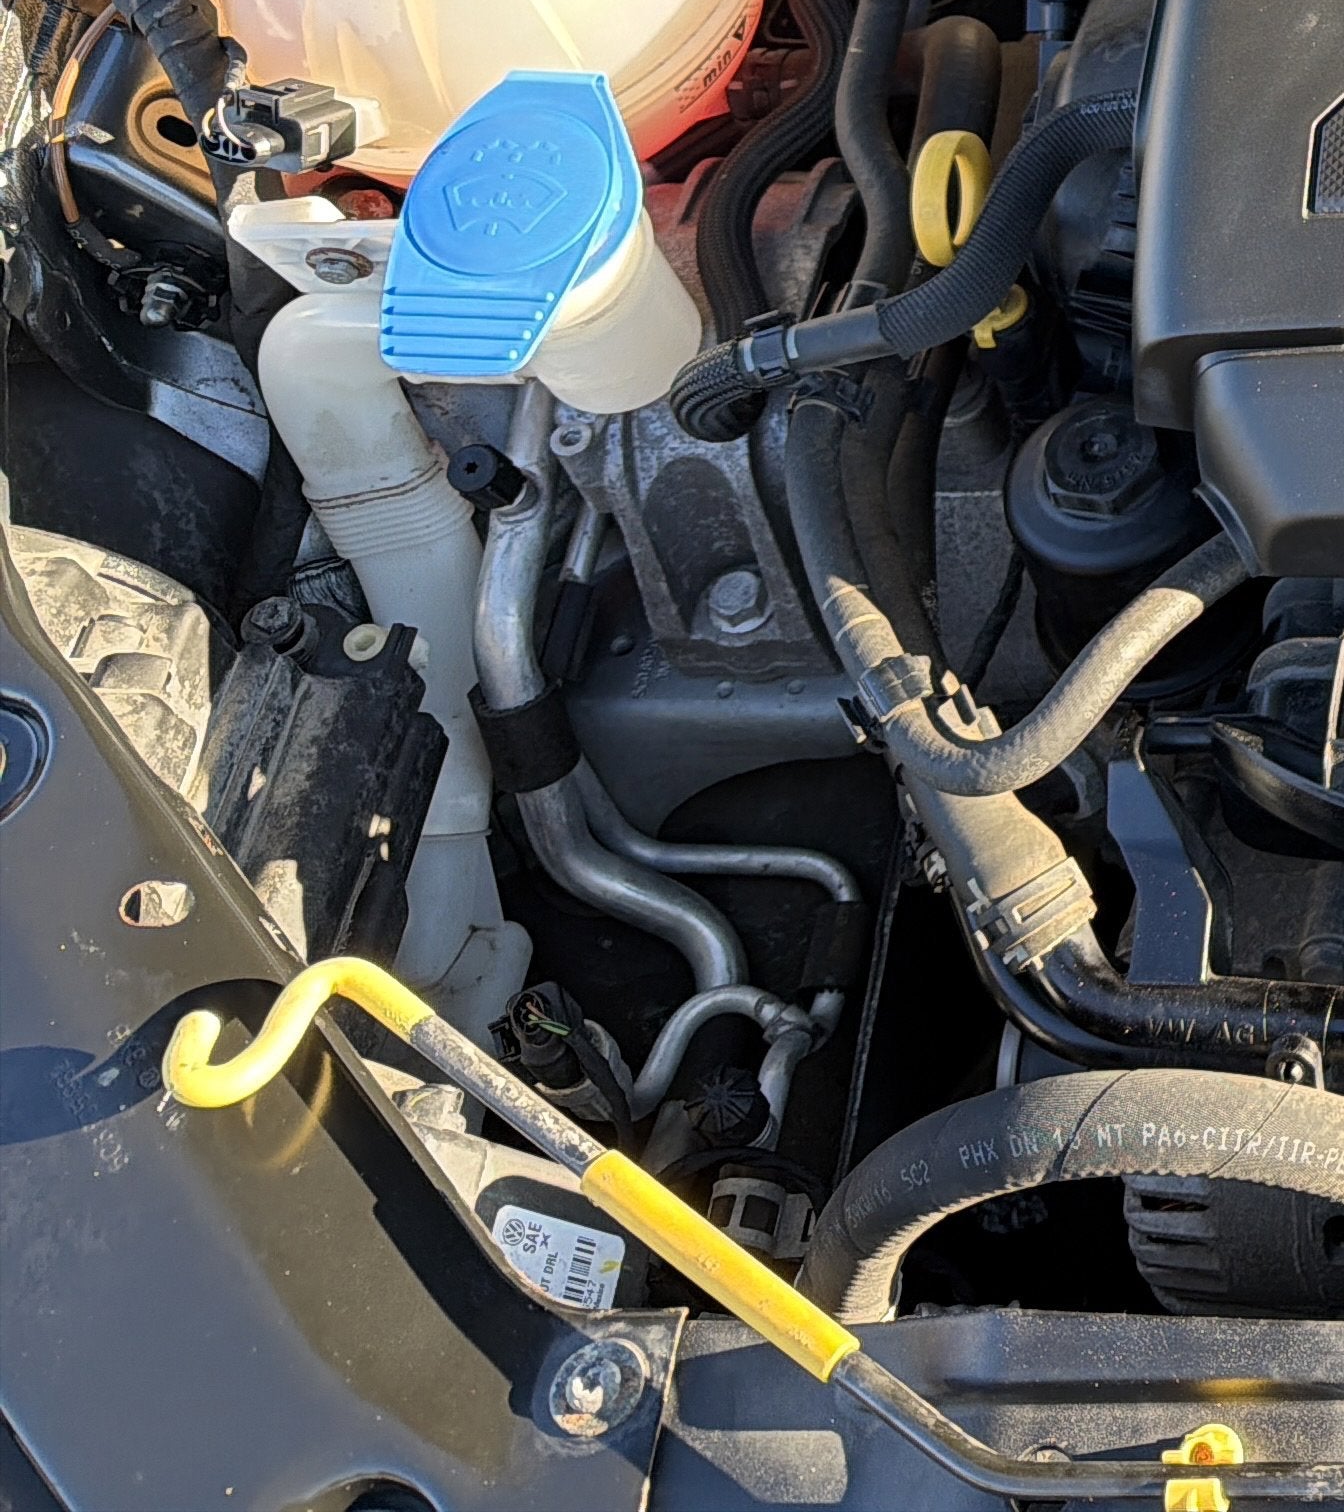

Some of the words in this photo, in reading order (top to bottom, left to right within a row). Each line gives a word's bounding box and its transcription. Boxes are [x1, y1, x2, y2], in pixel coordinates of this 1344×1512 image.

[704, 50, 732, 89] min
[958, 1141, 1000, 1170] PHX
[1009, 1131, 1040, 1158] DN
[1096, 1122, 1126, 1149] MT
[522, 1221, 543, 1255] SAE
[543, 1251, 559, 1276] DRL
